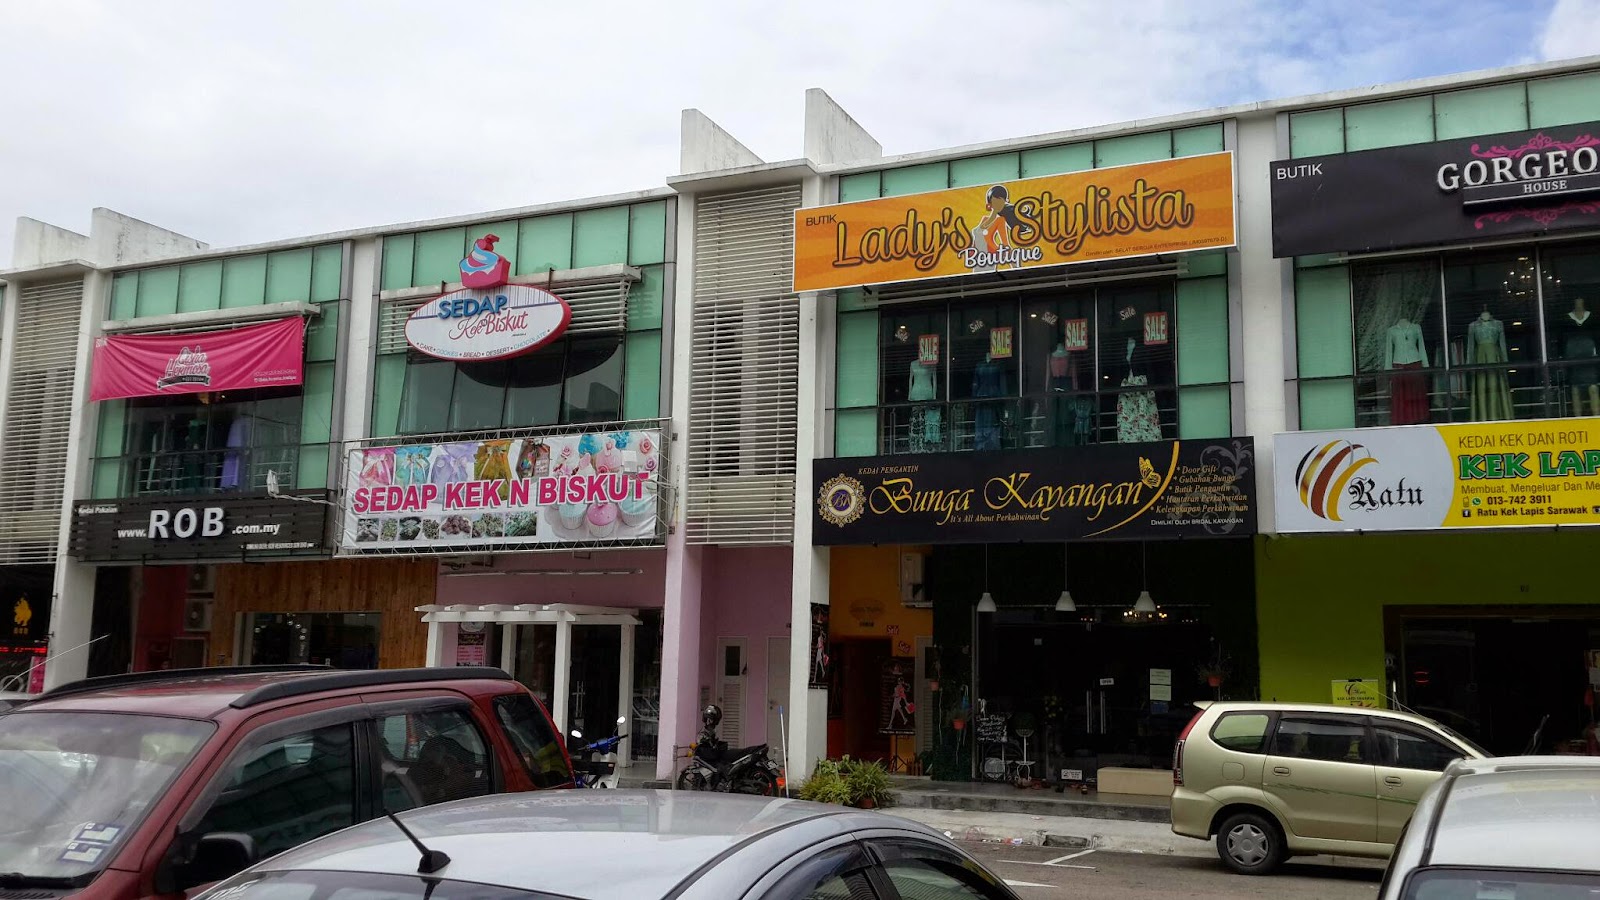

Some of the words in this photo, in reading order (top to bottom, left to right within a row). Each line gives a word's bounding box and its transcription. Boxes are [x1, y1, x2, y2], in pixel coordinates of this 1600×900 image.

[1276, 163, 1323, 180] BUTIK
[1523, 180, 1568, 193] HOUSE
[805, 213, 837, 227] BUTIK
[832, 207, 974, 271] Lady's
[1010, 178, 1194, 256] Stylista
[957, 245, 1043, 269] Boutique
[437, 295, 508, 320] SEDAP
[1119, 306, 1137, 320] Sale
[449, 315, 482, 340] Kek
[485, 310, 529, 335] Biskut
[969, 320, 984, 333] Sale
[1041, 311, 1059, 326] Sale
[1066, 321, 1087, 348] SALE
[1145, 315, 1168, 342] SALE
[419, 343, 434, 352] CAKE
[436, 348, 459, 357] COOKIES
[485, 346, 510, 356] DESSERT
[513, 331, 547, 350] CHOCOLATE
[920, 337, 939, 363] SALE
[991, 330, 1012, 357] SALE
[1459, 435, 1495, 448] KEDAI
[1500, 434, 1524, 447] KEK
[1528, 432, 1554, 445] DAN
[1559, 431, 1588, 444] ROTI
[858, 467, 879, 475] KEDAI
[880, 465, 919, 474] PENGANTIN
[1182, 466, 1201, 474] Door
[1202, 465, 1217, 474] Gift
[1458, 452, 1532, 480] KEK
[1179, 475, 1211, 483] Gubahan
[1212, 475, 1236, 483] Bunga
[352, 483, 438, 515] SEDAP
[445, 479, 503, 510] KEK
[509, 477, 530, 507] N
[538, 471, 651, 506] BISKUT
[1195, 485, 1231, 494] Pengantin
[1348, 477, 1425, 512] Ratu
[1461, 485, 1508, 494] Membuat,
[1511, 483, 1560, 494] Mengeluar
[1564, 482, 1583, 491] Dan
[869, 477, 975, 526] Bunga
[984, 473, 1142, 521] Kayangan
[1487, 495, 1526, 505] 013-742
[1530, 495, 1552, 504] 3911
[78, 506, 95, 514] Kedai
[95, 505, 118, 513] Pakaian
[1155, 505, 1200, 514] Kelengkapan
[1202, 504, 1249, 512] Perkahwinan
[1477, 508, 1498, 517] Ratu
[1501, 507, 1518, 516] Kek
[1520, 506, 1545, 517] Lapis
[1547, 505, 1588, 515] Sarawak
[118, 528, 147, 538] www.
[148, 507, 225, 539] ROB
[232, 523, 281, 536] .com.my
[950, 514, 962, 523] It's
[963, 514, 974, 523] All
[975, 514, 995, 523] About
[996, 513, 1040, 522] Perkahwinan
